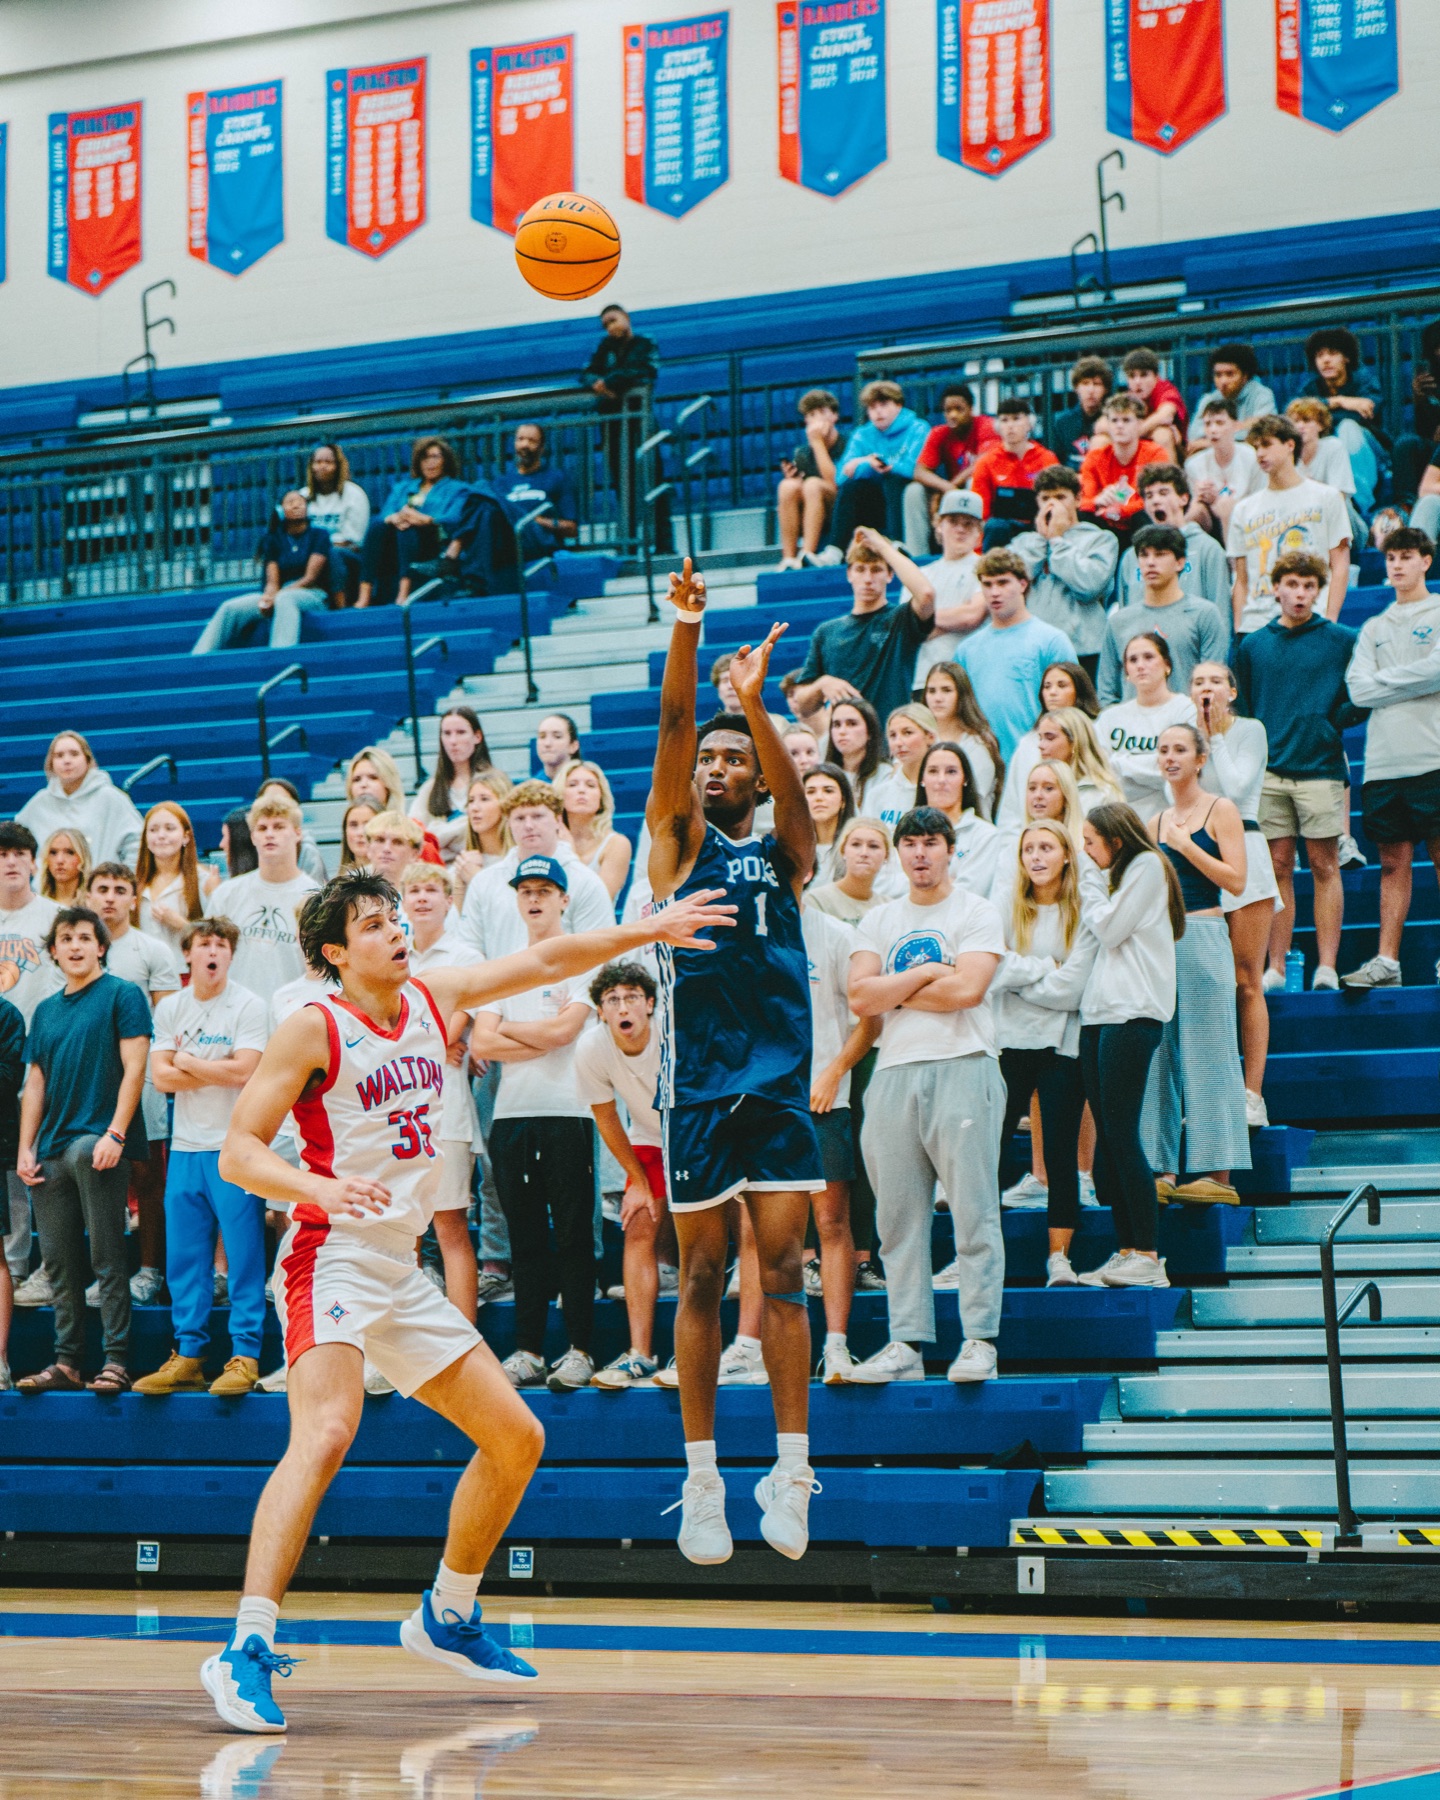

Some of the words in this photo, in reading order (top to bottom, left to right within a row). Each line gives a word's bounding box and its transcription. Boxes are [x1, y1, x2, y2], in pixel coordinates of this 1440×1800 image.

[802, 0, 880, 25] RAIDERS
[647, 20, 723, 48] RAIDERS
[943, 5, 956, 60] TENNIS
[810, 36, 873, 60] CHAMPS
[655, 59, 715, 82] CHAMPS
[943, 66, 957, 105] BOYS
[1111, 728, 1159, 751] Iow
[754, 891, 768, 937] 1
[242, 926, 297, 944] OFFORD
[355, 1055, 444, 1112] WALTON
[388, 1103, 436, 1160] 35
